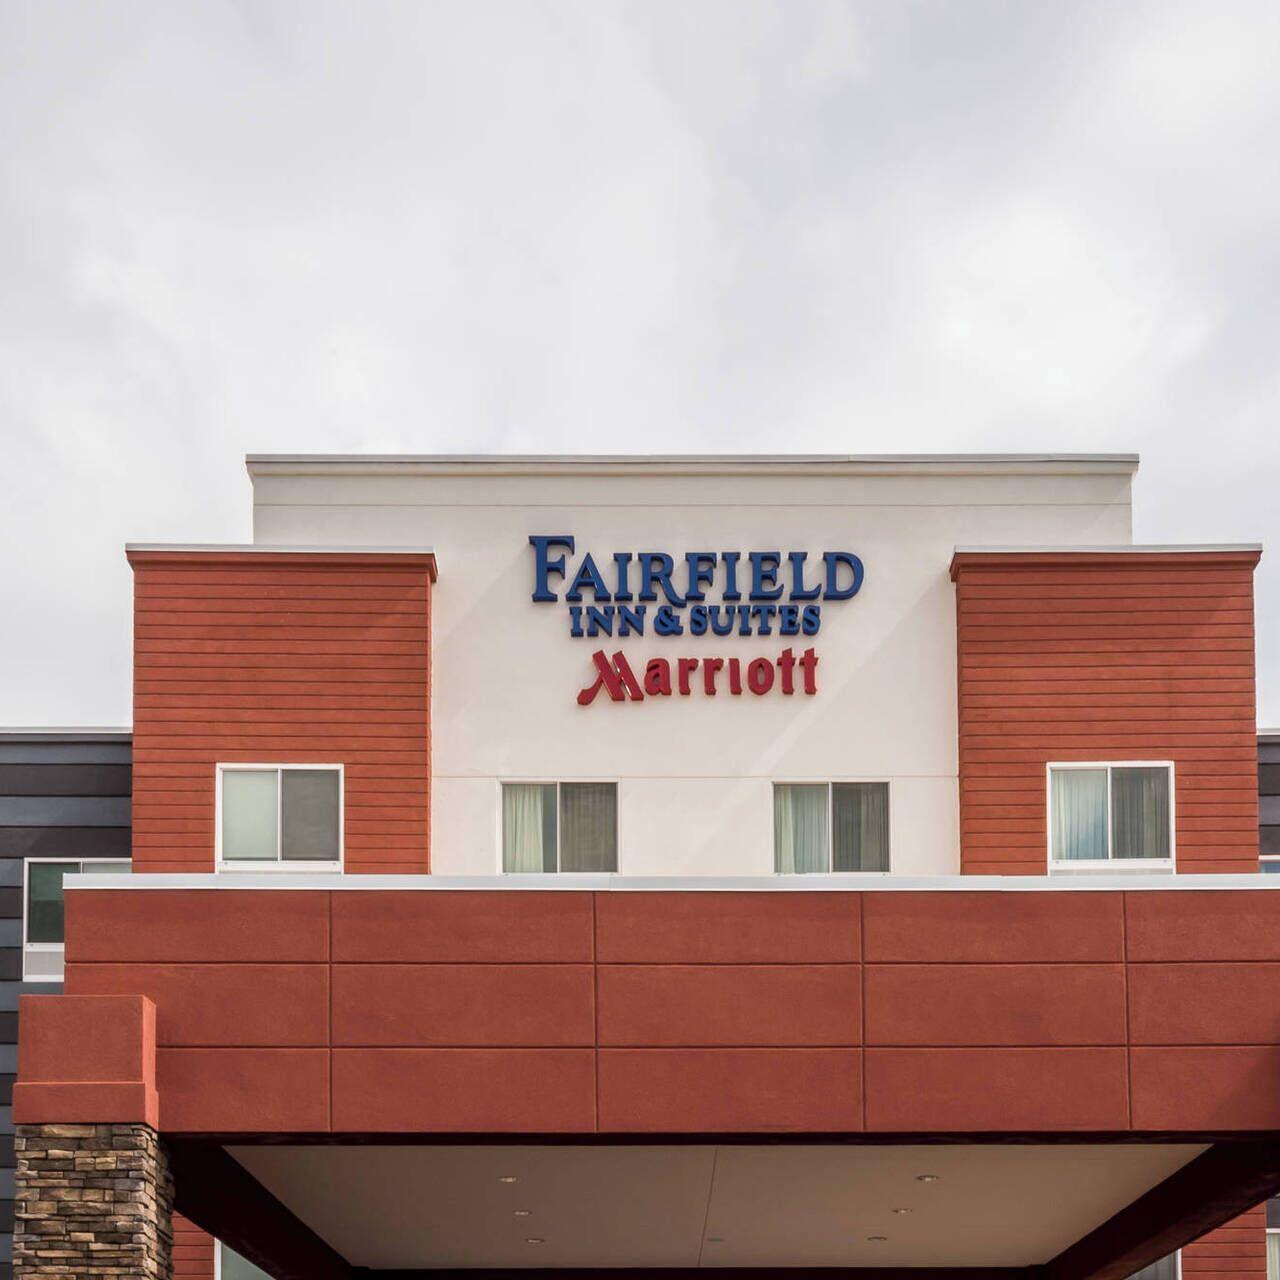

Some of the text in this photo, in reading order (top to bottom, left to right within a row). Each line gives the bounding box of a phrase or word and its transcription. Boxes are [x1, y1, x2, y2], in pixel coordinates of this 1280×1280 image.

[528, 535, 864, 608] FAIRFIELD
[570, 605, 646, 637] INN
[690, 605, 821, 636] SUITES
[577, 647, 819, 706] Marriott
